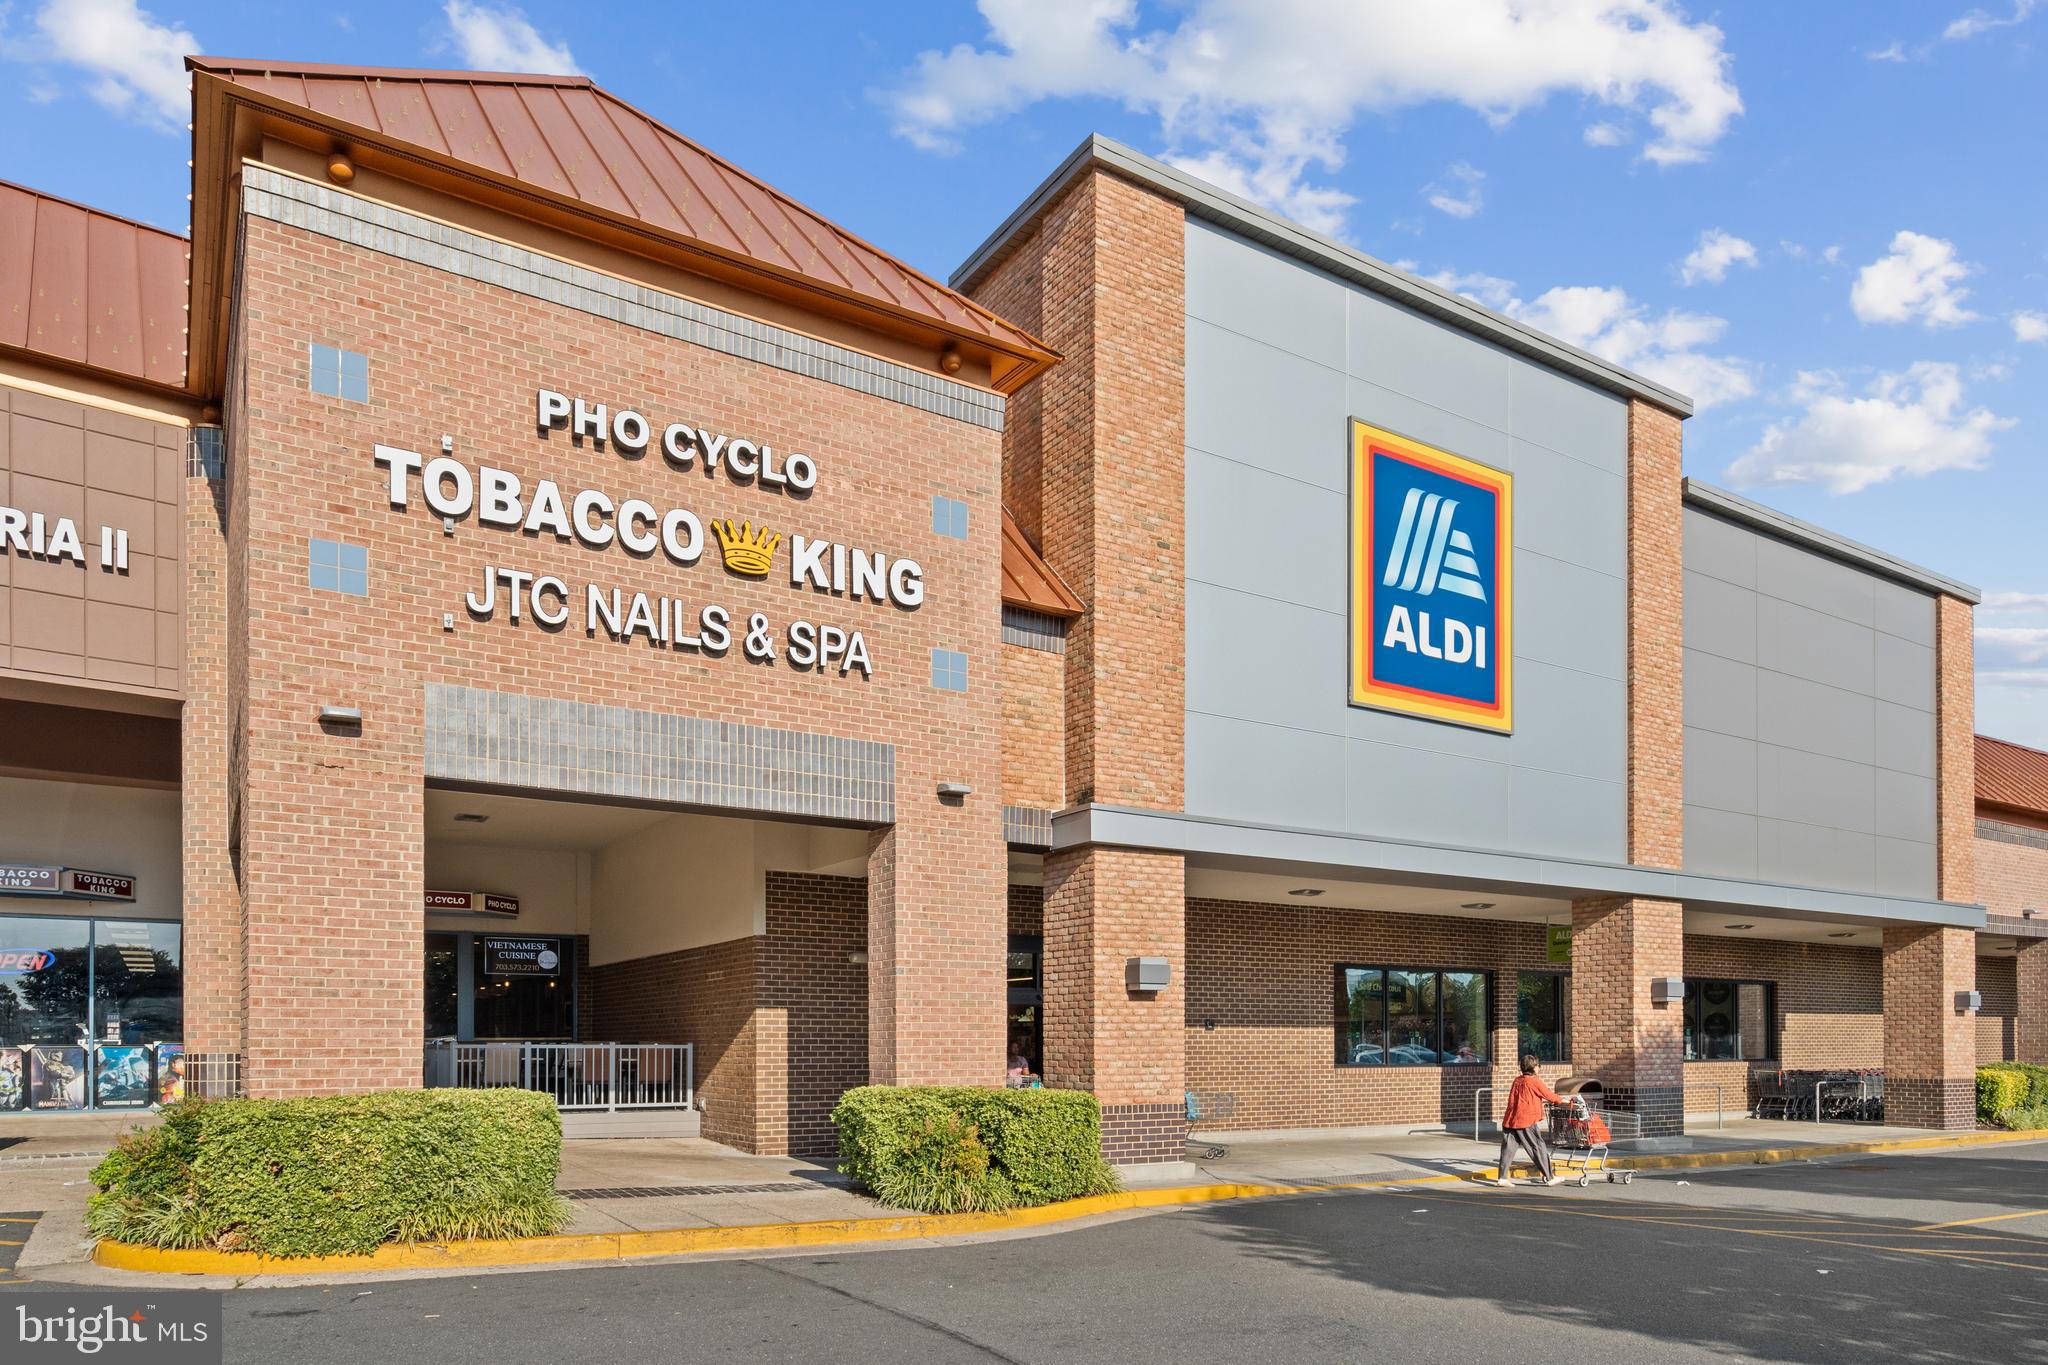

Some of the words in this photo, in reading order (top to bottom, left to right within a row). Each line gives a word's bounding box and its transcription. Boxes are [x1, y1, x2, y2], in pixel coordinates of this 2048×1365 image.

[537, 388, 650, 452] PHO
[664, 423, 818, 492] CYCLO
[374, 444, 705, 561] TOBACCO
[790, 534, 924, 607] KING
[101, 525, 128, 569] II
[467, 565, 569, 625] JTC
[587, 583, 731, 650] NAILS
[745, 612, 776, 660] &
[788, 620, 873, 675] SPA
[1382, 604, 1486, 669] ALDI
[76, 874, 128, 888] TOBACCO
[90, 884, 116, 895] KING
[434, 896, 466, 905] CYCLO
[487, 899, 500, 908] PHO
[499, 901, 517, 911] CYCLO
[487, 941, 548, 951] VIETNAMESE
[498, 951, 537, 960] CUISINE
